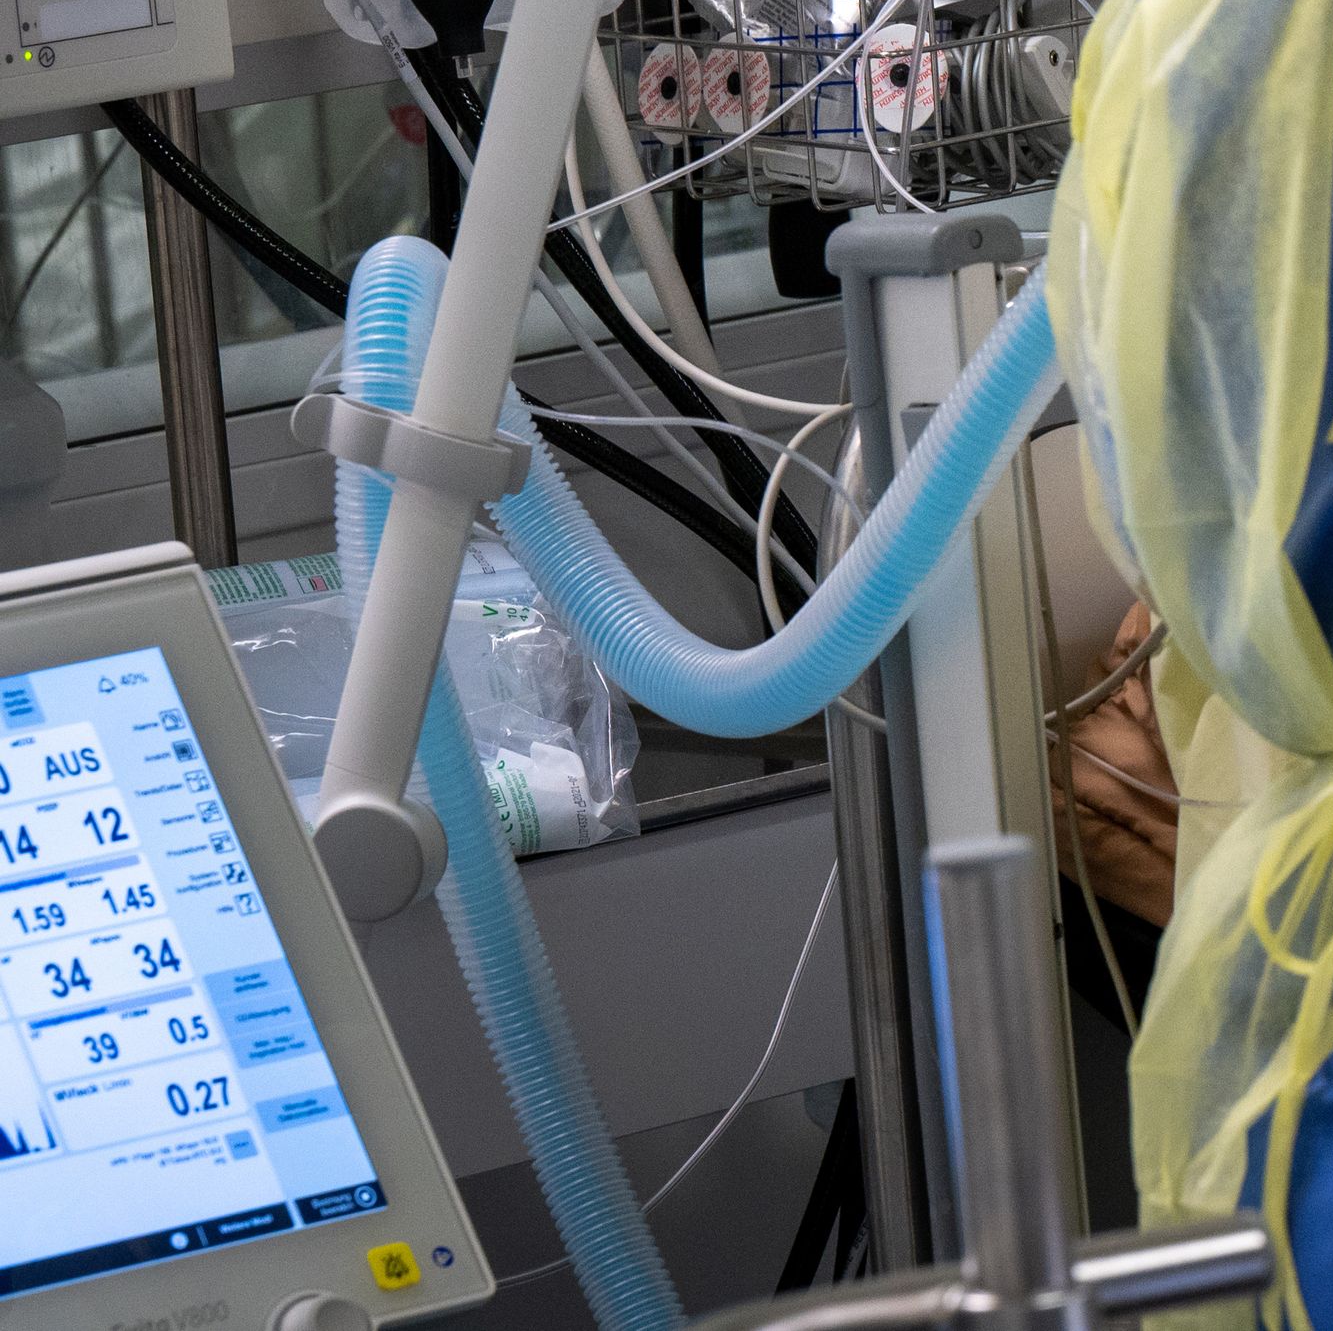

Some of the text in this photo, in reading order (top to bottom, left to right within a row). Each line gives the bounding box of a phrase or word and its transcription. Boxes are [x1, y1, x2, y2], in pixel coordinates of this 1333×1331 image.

[507, 606, 518, 621] 10
[45, 747, 102, 782] AUS
[0, 806, 130, 865] 14 12
[13, 882, 157, 935] 1.59 1.45
[43, 937, 183, 1000] 34 34
[83, 1014, 210, 1064] 39 0.5
[166, 1075, 231, 1118] 0.27
